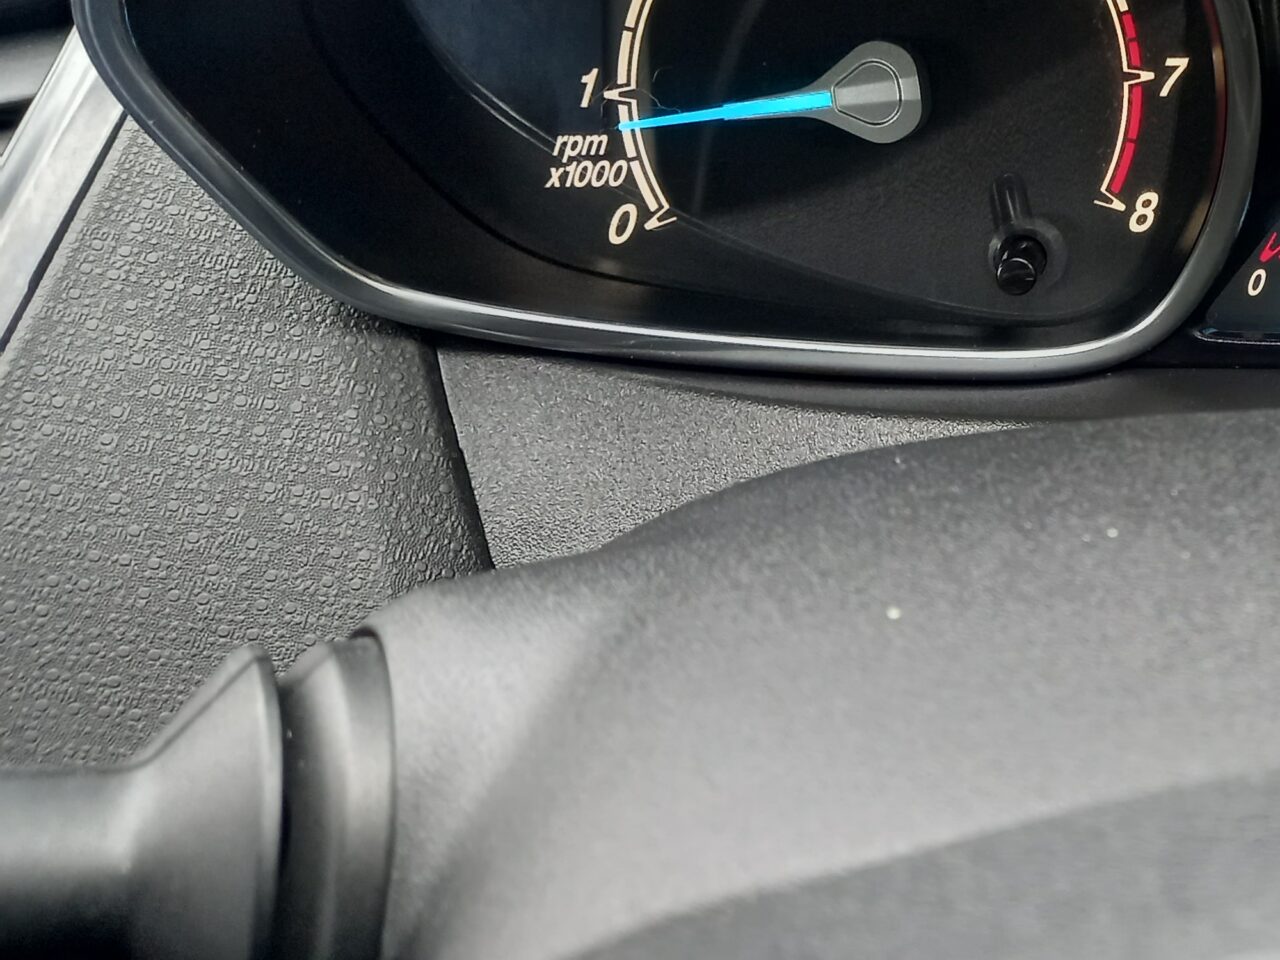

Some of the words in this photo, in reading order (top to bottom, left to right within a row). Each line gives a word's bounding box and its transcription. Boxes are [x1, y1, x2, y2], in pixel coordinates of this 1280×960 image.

[580, 68, 599, 108] 1
[1159, 57, 1189, 97] 7
[552, 133, 608, 162] rpm
[544, 159, 628, 188] x1000
[608, 204, 637, 245] 0
[1128, 192, 1159, 233] 8
[1247, 268, 1267, 297] 0
